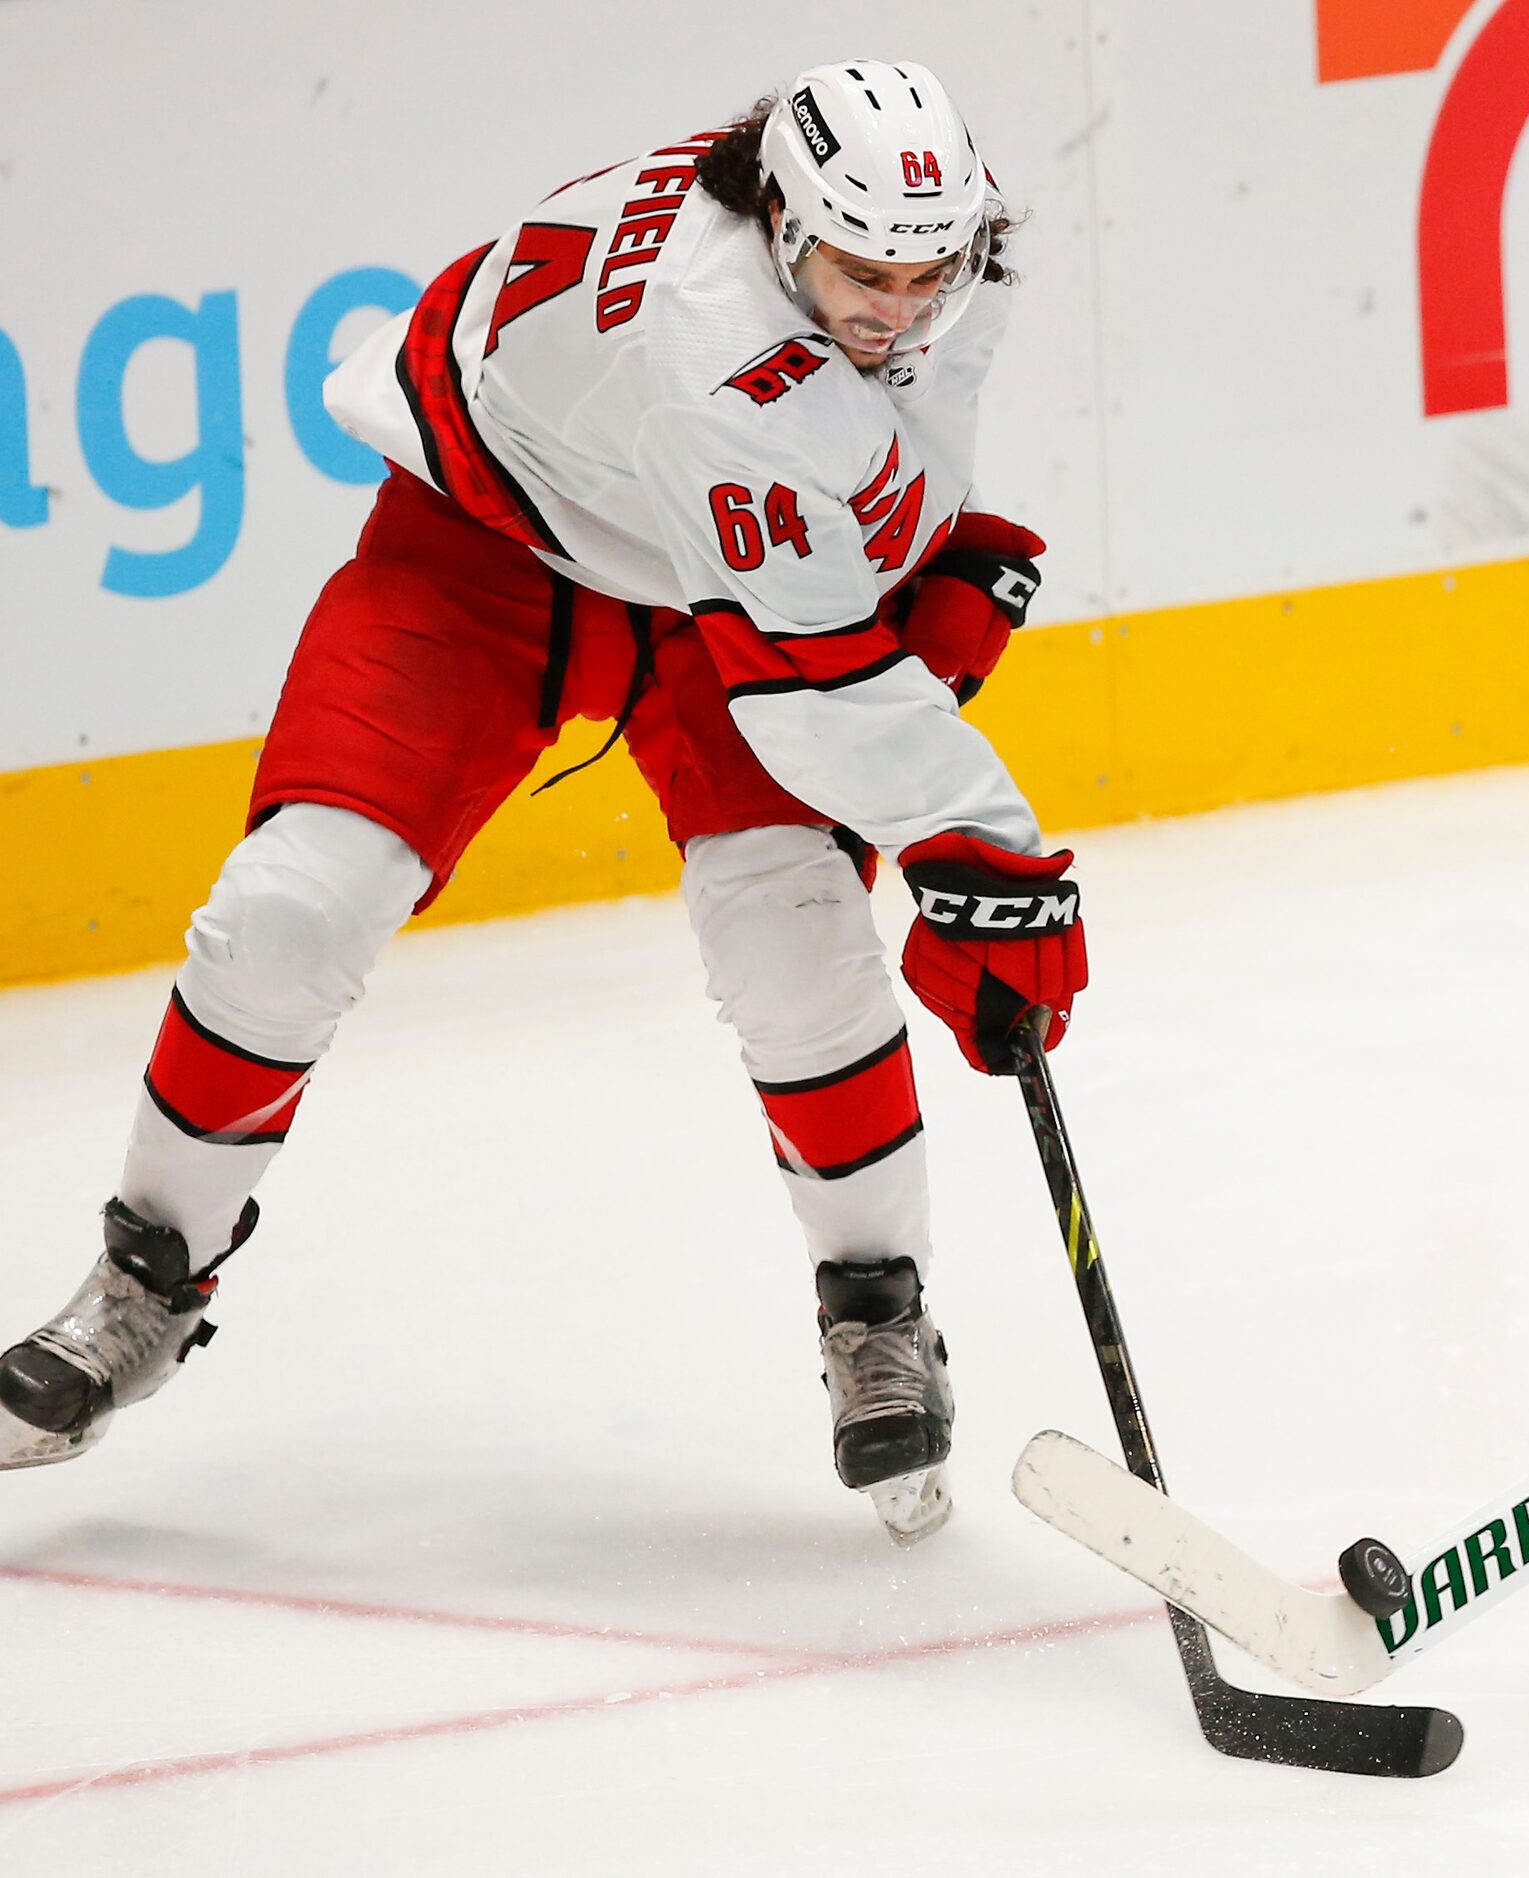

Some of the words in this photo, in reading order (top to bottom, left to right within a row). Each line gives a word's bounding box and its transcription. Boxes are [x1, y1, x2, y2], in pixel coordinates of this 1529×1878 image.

[793, 93, 830, 157] Lenovo
[900, 150, 943, 188] 64
[597, 146, 714, 334] FIELD
[888, 219, 955, 235] CCM
[0, 264, 432, 600] ge
[708, 481, 813, 573] 64
[917, 886, 1078, 930] CCM
